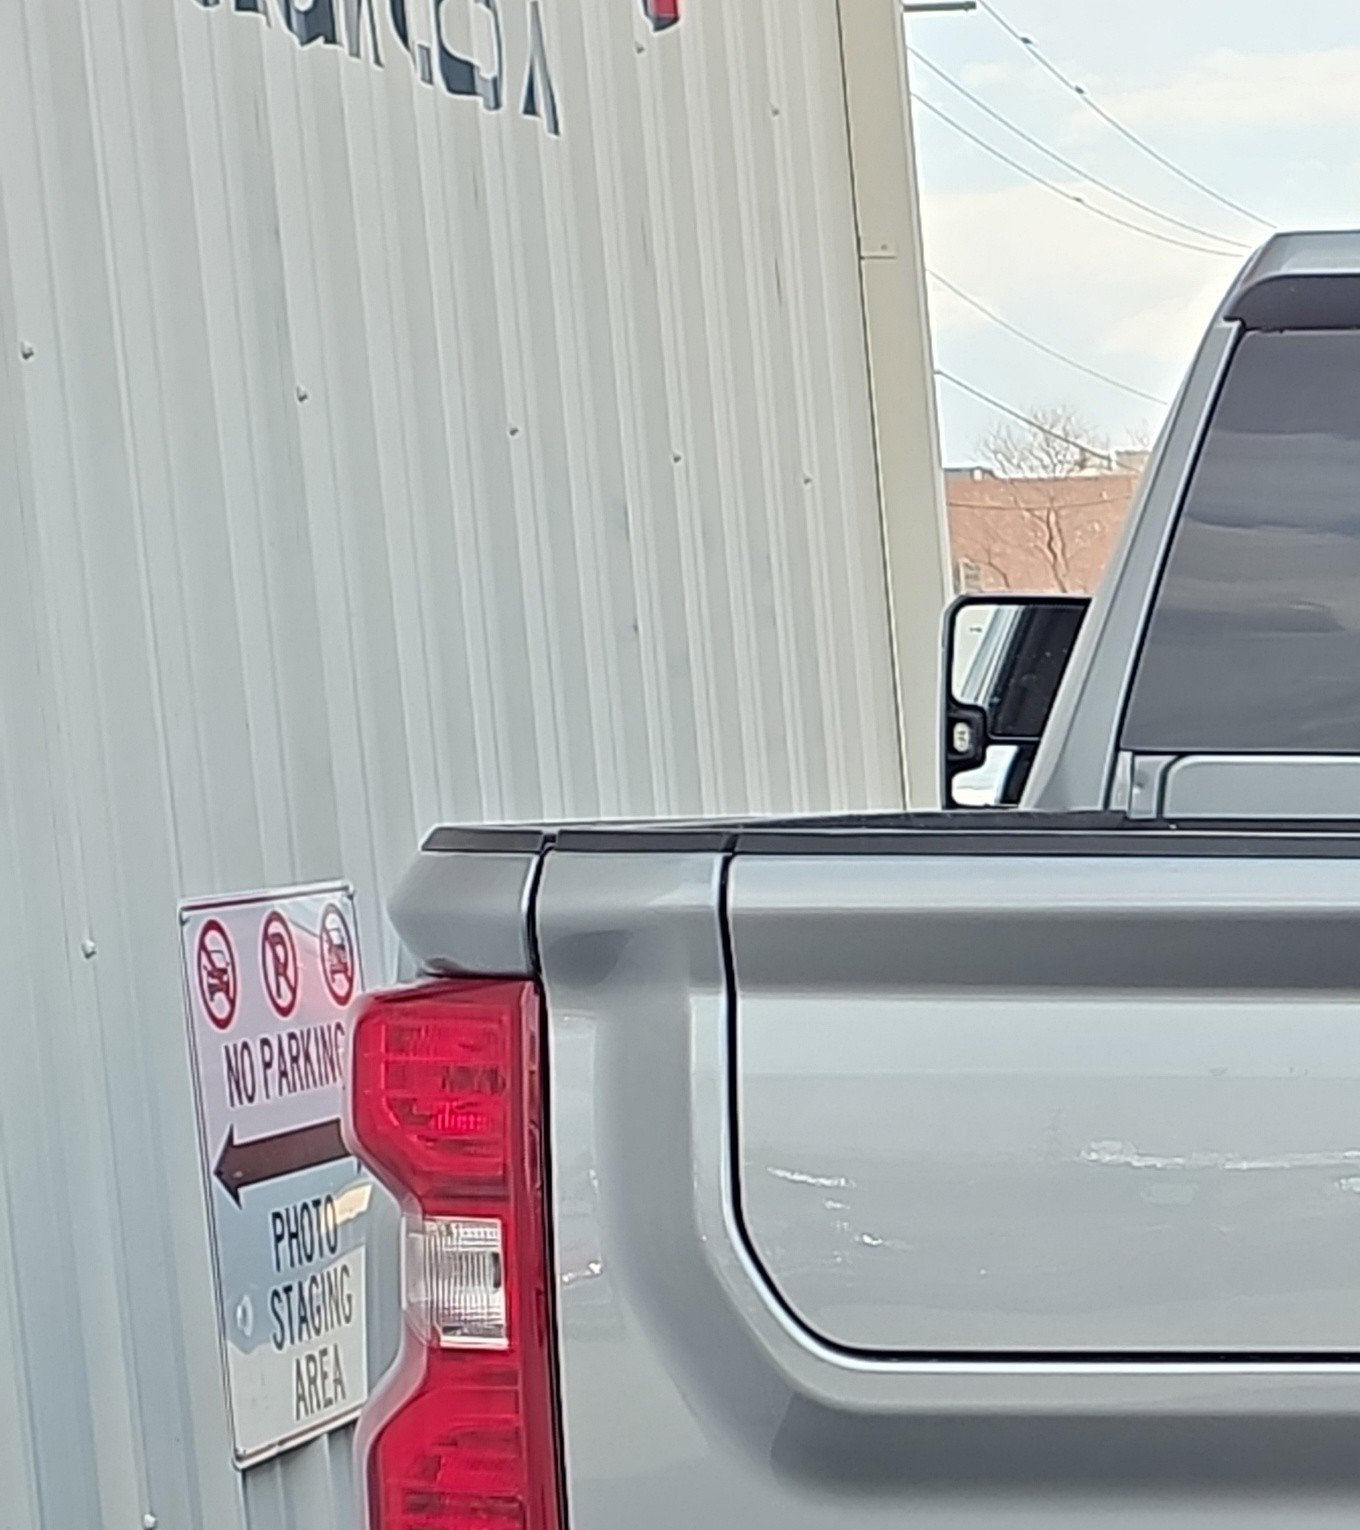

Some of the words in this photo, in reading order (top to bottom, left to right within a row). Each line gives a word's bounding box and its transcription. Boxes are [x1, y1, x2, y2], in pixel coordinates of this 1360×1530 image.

[224, 1040, 256, 1108] NO
[271, 1194, 339, 1273] PHOTO
[270, 1264, 353, 1352] STAGING
[295, 1344, 347, 1421] AREA
